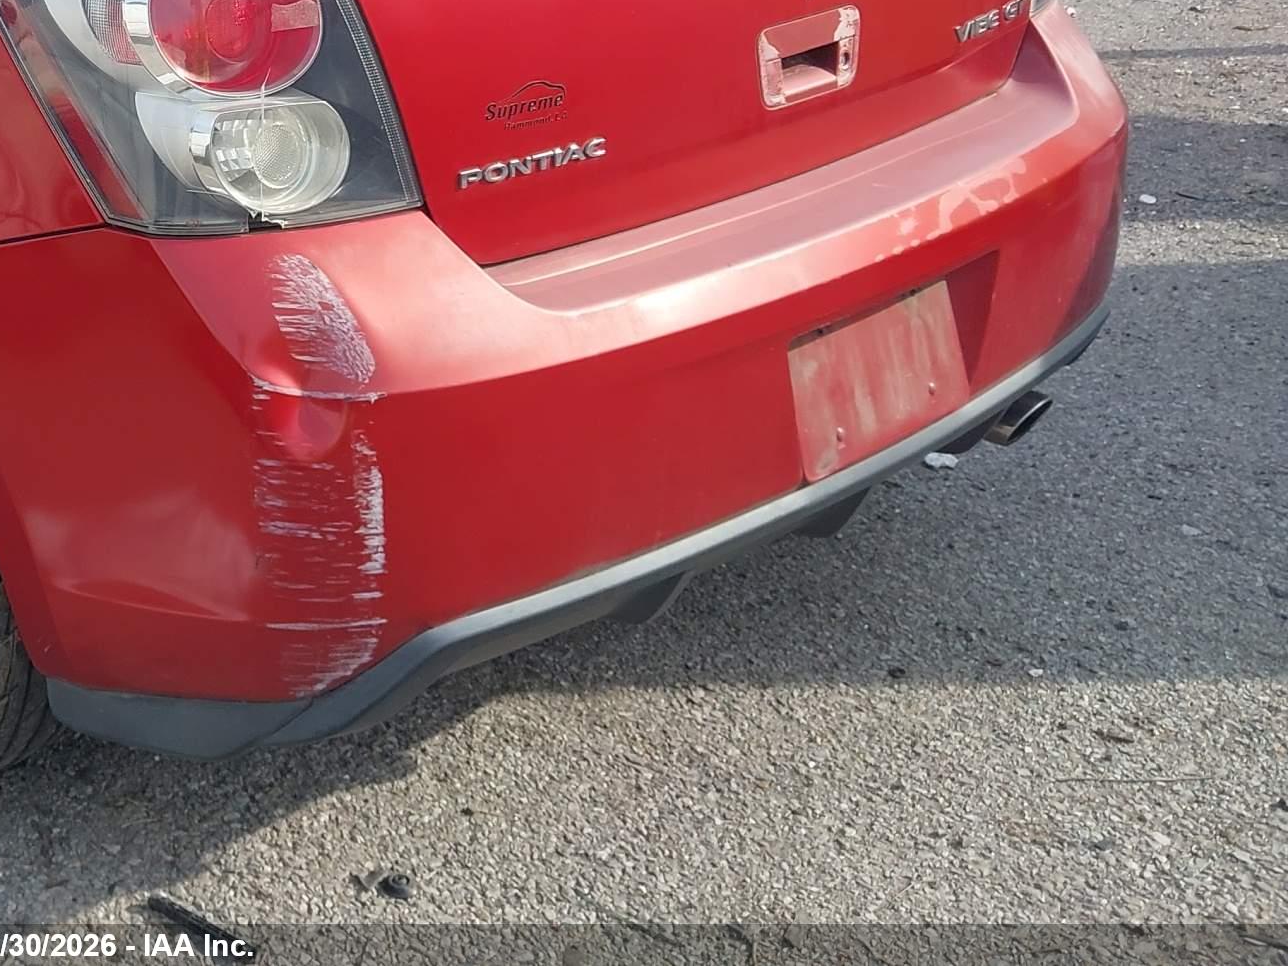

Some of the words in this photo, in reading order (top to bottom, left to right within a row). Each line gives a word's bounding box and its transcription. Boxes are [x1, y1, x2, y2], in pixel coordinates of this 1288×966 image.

[953, 9, 1000, 43] VIBE
[485, 94, 563, 121] Supreme
[457, 137, 607, 190] PONTIAC
